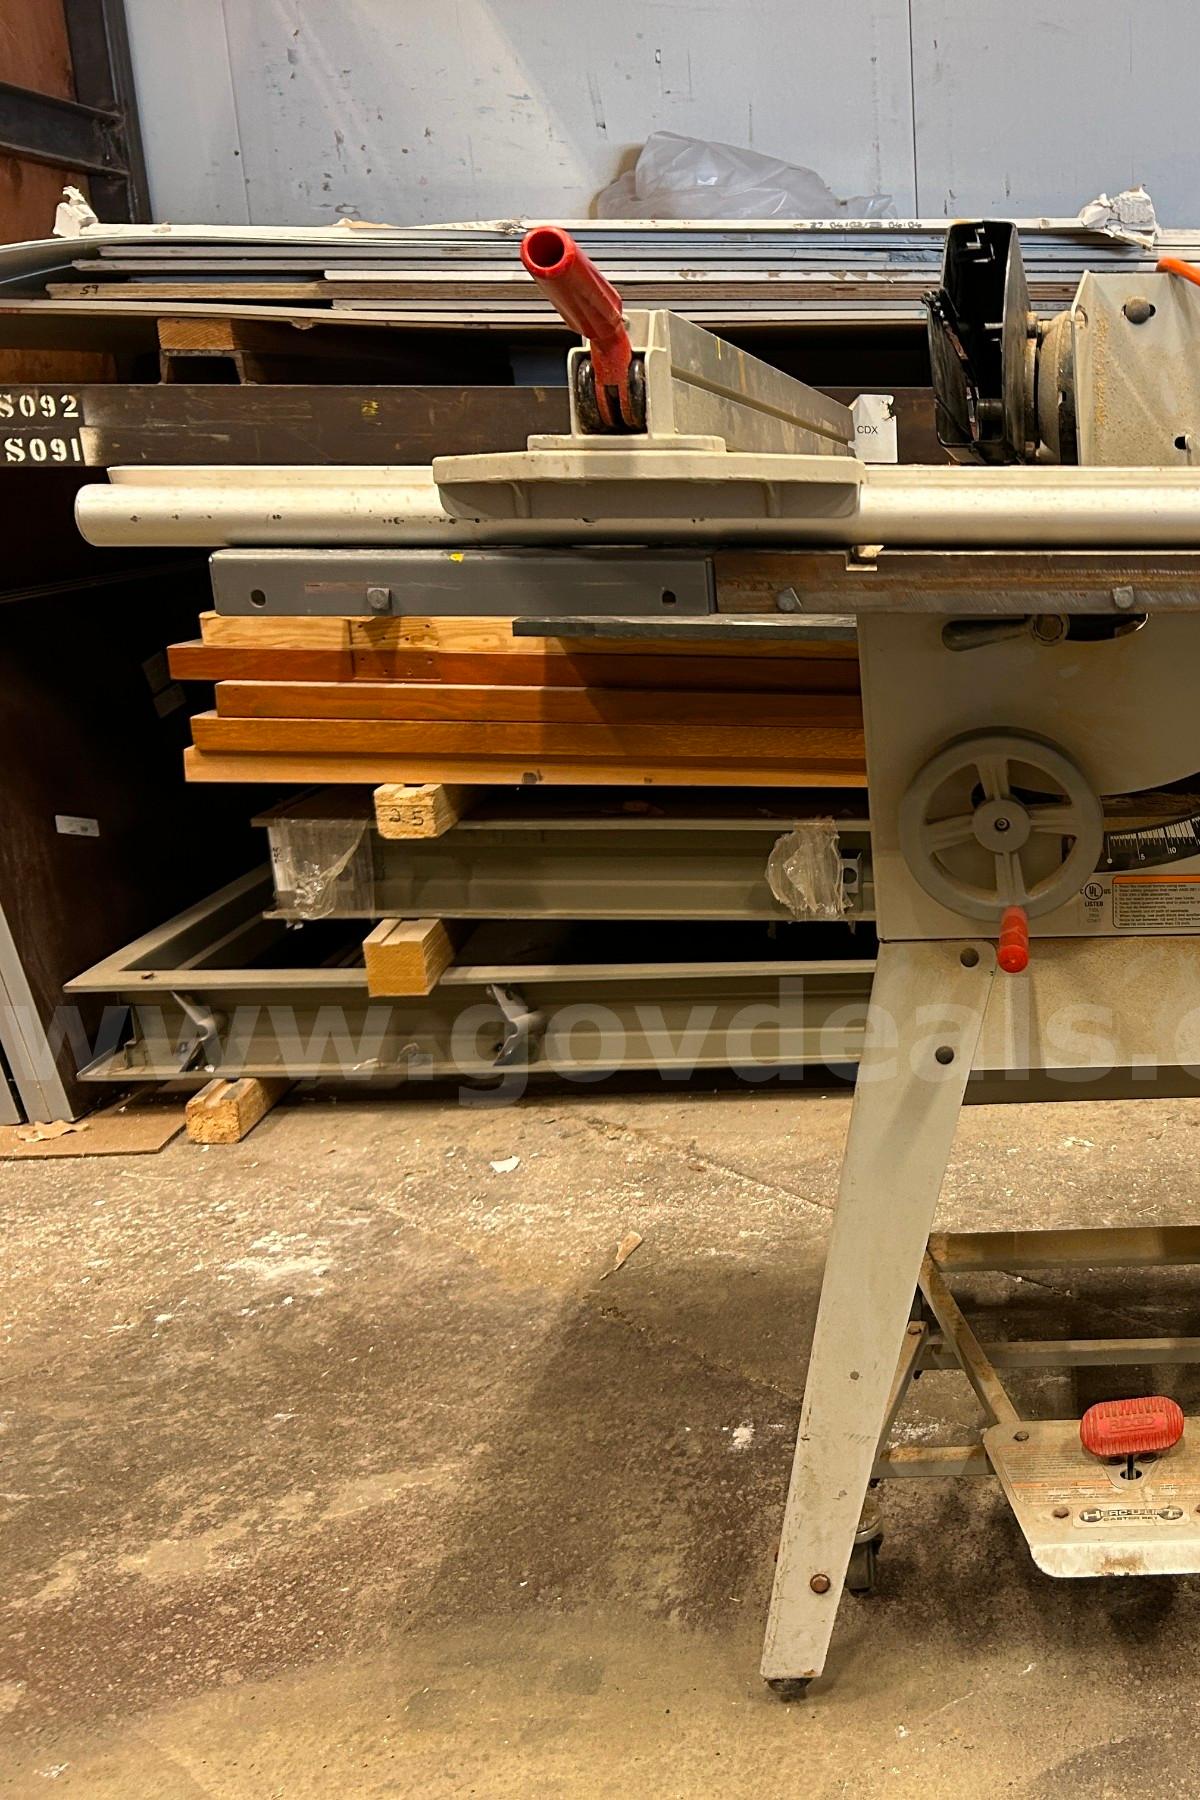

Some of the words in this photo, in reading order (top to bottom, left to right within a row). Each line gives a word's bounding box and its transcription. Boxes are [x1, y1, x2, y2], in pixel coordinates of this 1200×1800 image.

[0, 394, 79, 418] S092
[856, 425, 878, 434] CDX
[4, 438, 81, 462] S091
